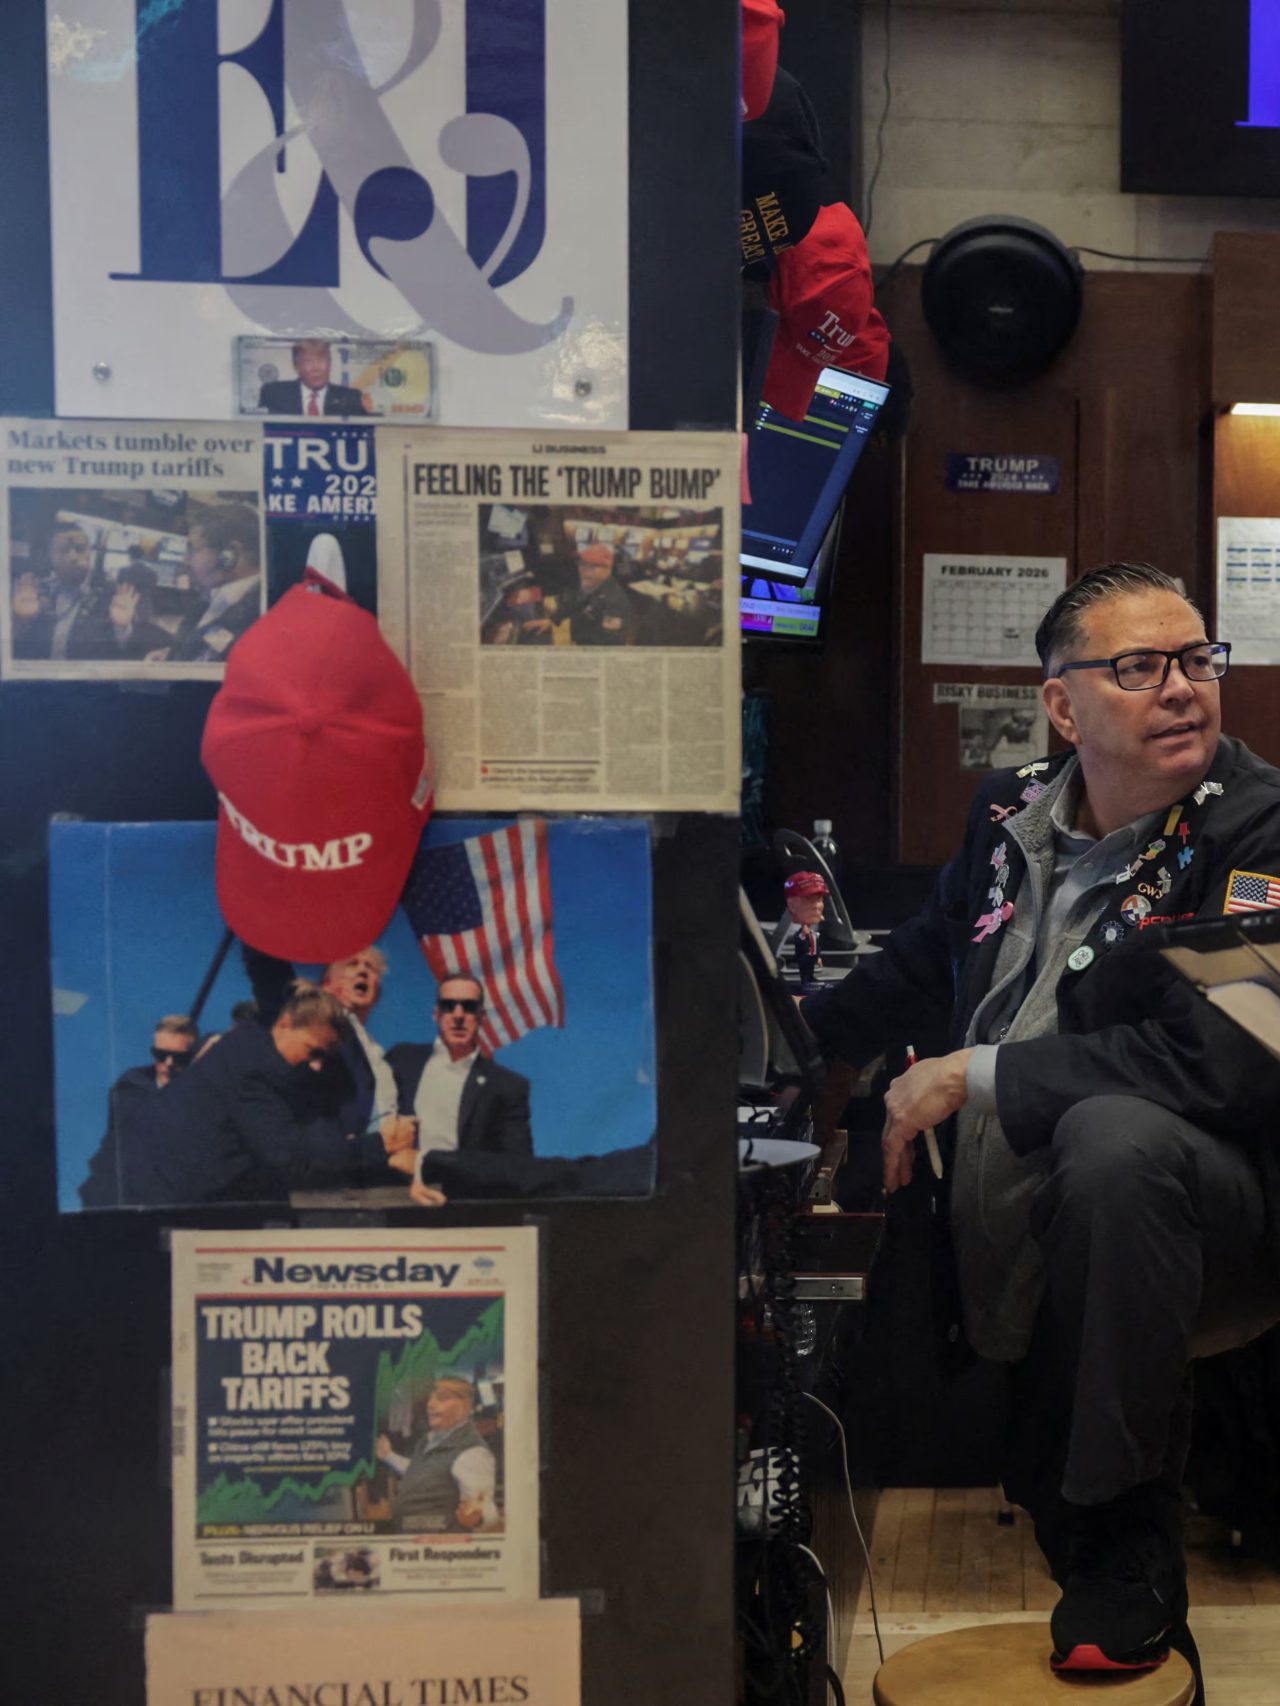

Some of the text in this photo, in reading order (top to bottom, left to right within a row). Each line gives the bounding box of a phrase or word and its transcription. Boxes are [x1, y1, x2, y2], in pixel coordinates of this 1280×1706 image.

[755, 191, 788, 241] MAKE
[8, 431, 254, 453] Markets tumble over
[8, 457, 224, 480] new Trump tariffs
[414, 463, 501, 496] FEELING
[509, 465, 550, 497] THE
[966, 457, 1039, 473] TRUMP
[264, 495, 296, 512] KE
[941, 565, 1049, 578] FEBRUARY 2026
[936, 684, 1038, 701] RISKY BUSINESS
[218, 791, 373, 871] TRUMP
[253, 1256, 460, 1288] Newsday
[202, 1304, 424, 1339] TRUMP ROLLS
[241, 1341, 331, 1375] BACK
[221, 1376, 351, 1411] TARIFFS
[389, 1547, 501, 1563] First Responders
[191, 1675, 529, 1706] FINANCIAL TIMES
